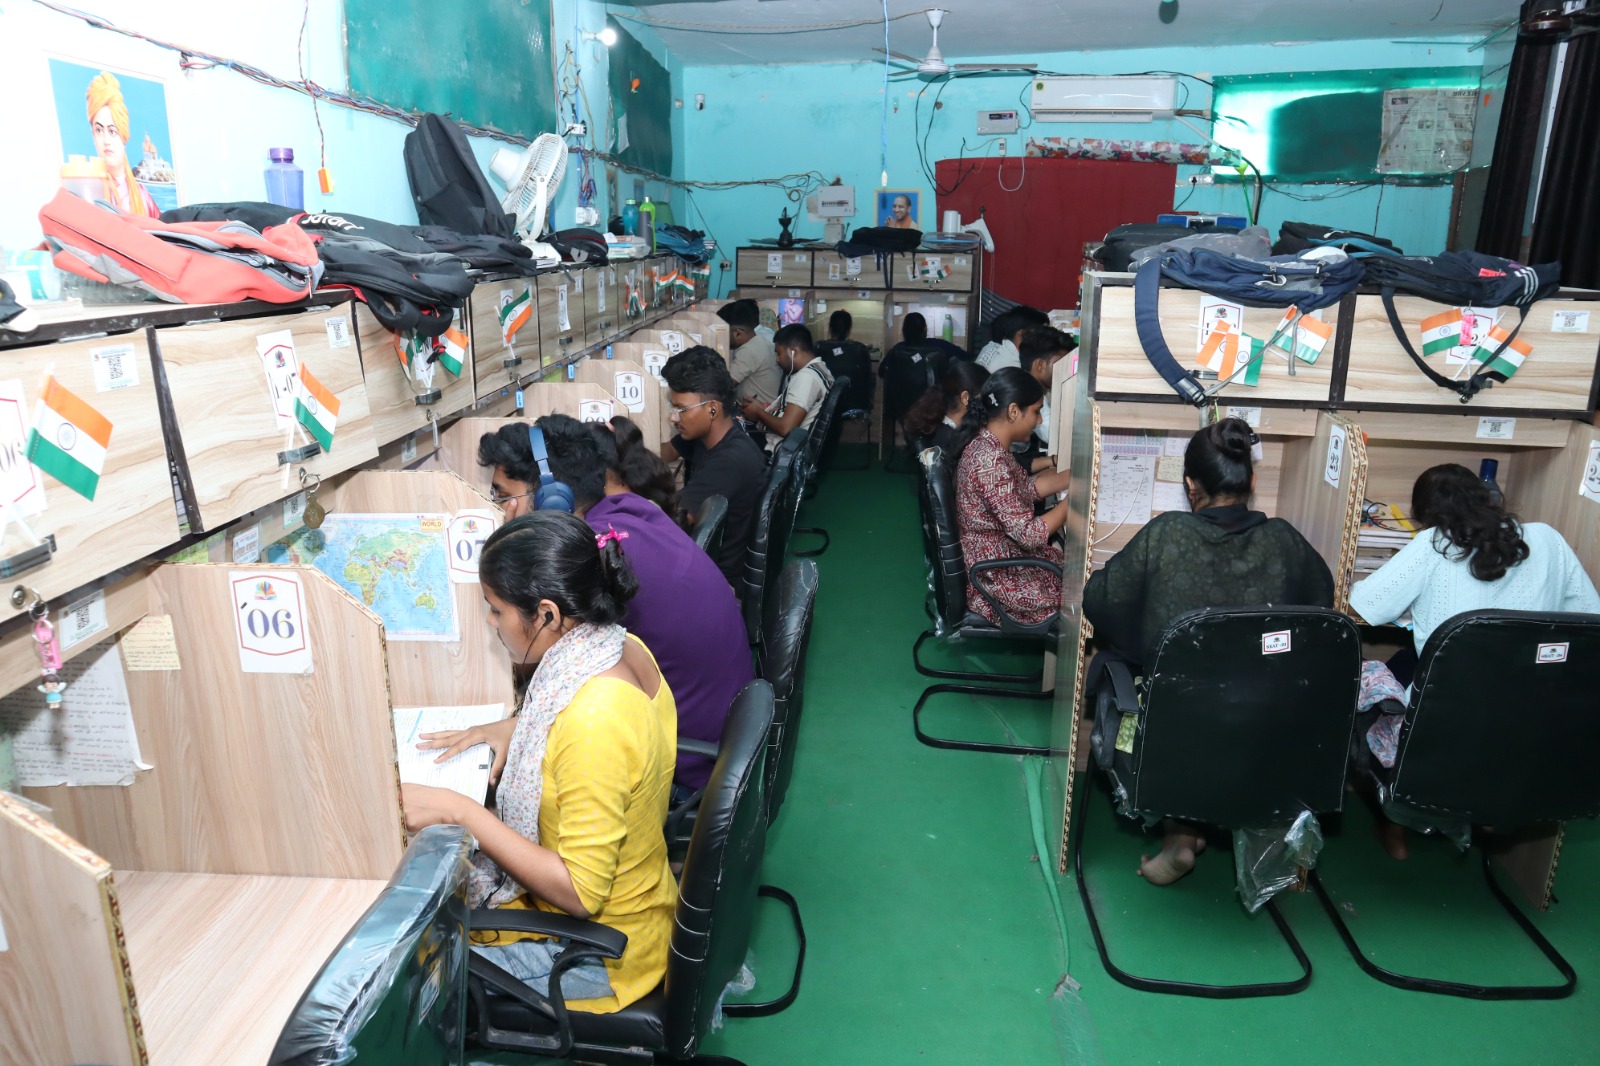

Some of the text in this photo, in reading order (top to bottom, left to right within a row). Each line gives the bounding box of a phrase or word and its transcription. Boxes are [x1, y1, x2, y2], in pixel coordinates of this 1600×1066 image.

[621, 386, 639, 399] 10
[1329, 452, 1340, 472] 23
[247, 608, 295, 638] 06
